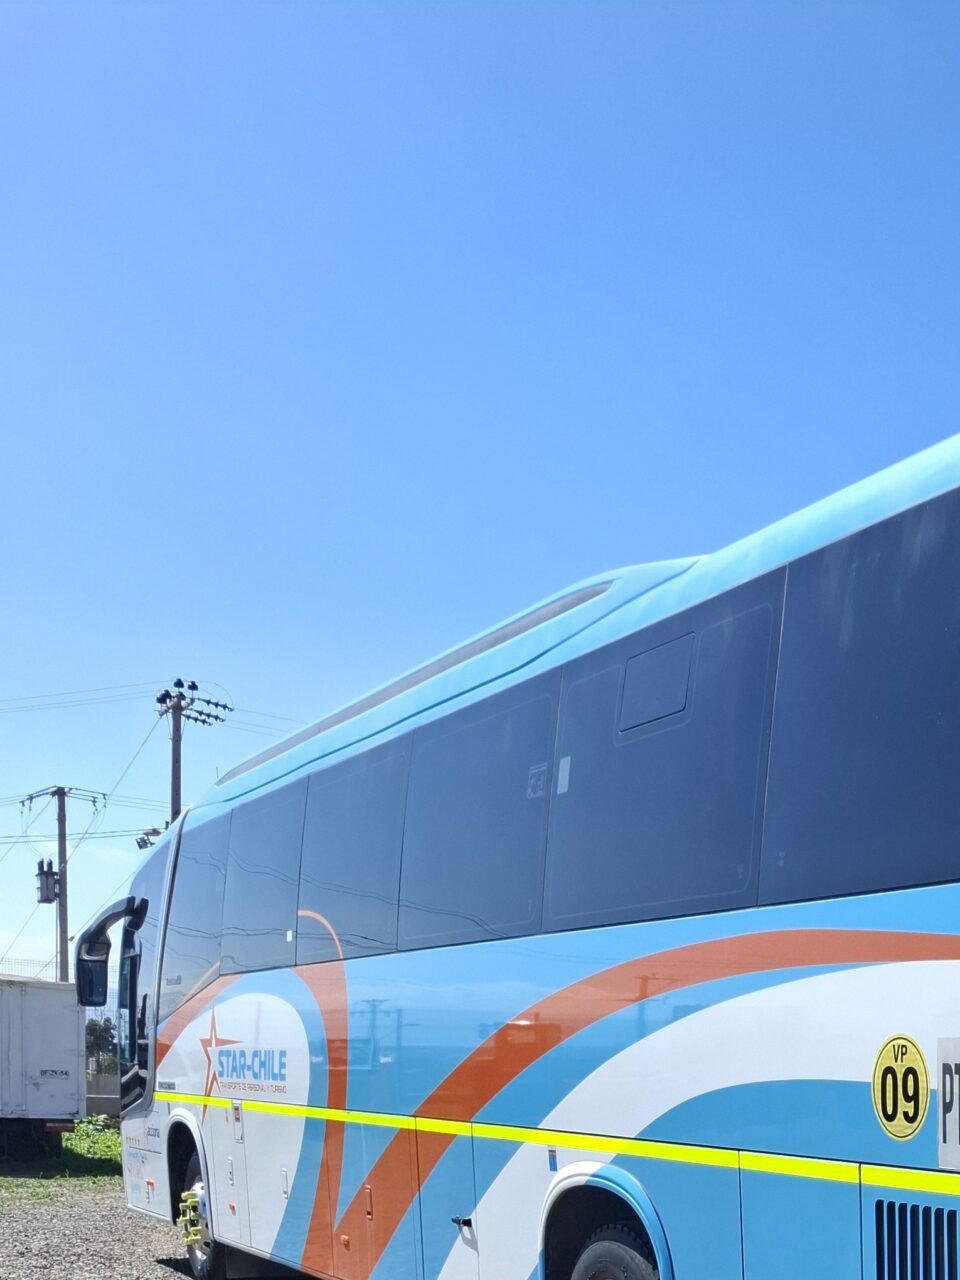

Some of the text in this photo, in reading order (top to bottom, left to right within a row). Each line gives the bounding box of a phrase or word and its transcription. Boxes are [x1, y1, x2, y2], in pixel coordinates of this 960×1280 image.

[217, 1049, 287, 1081] STAR-CHILE
[893, 1044, 908, 1063] VP
[881, 1066, 920, 1124] 09
